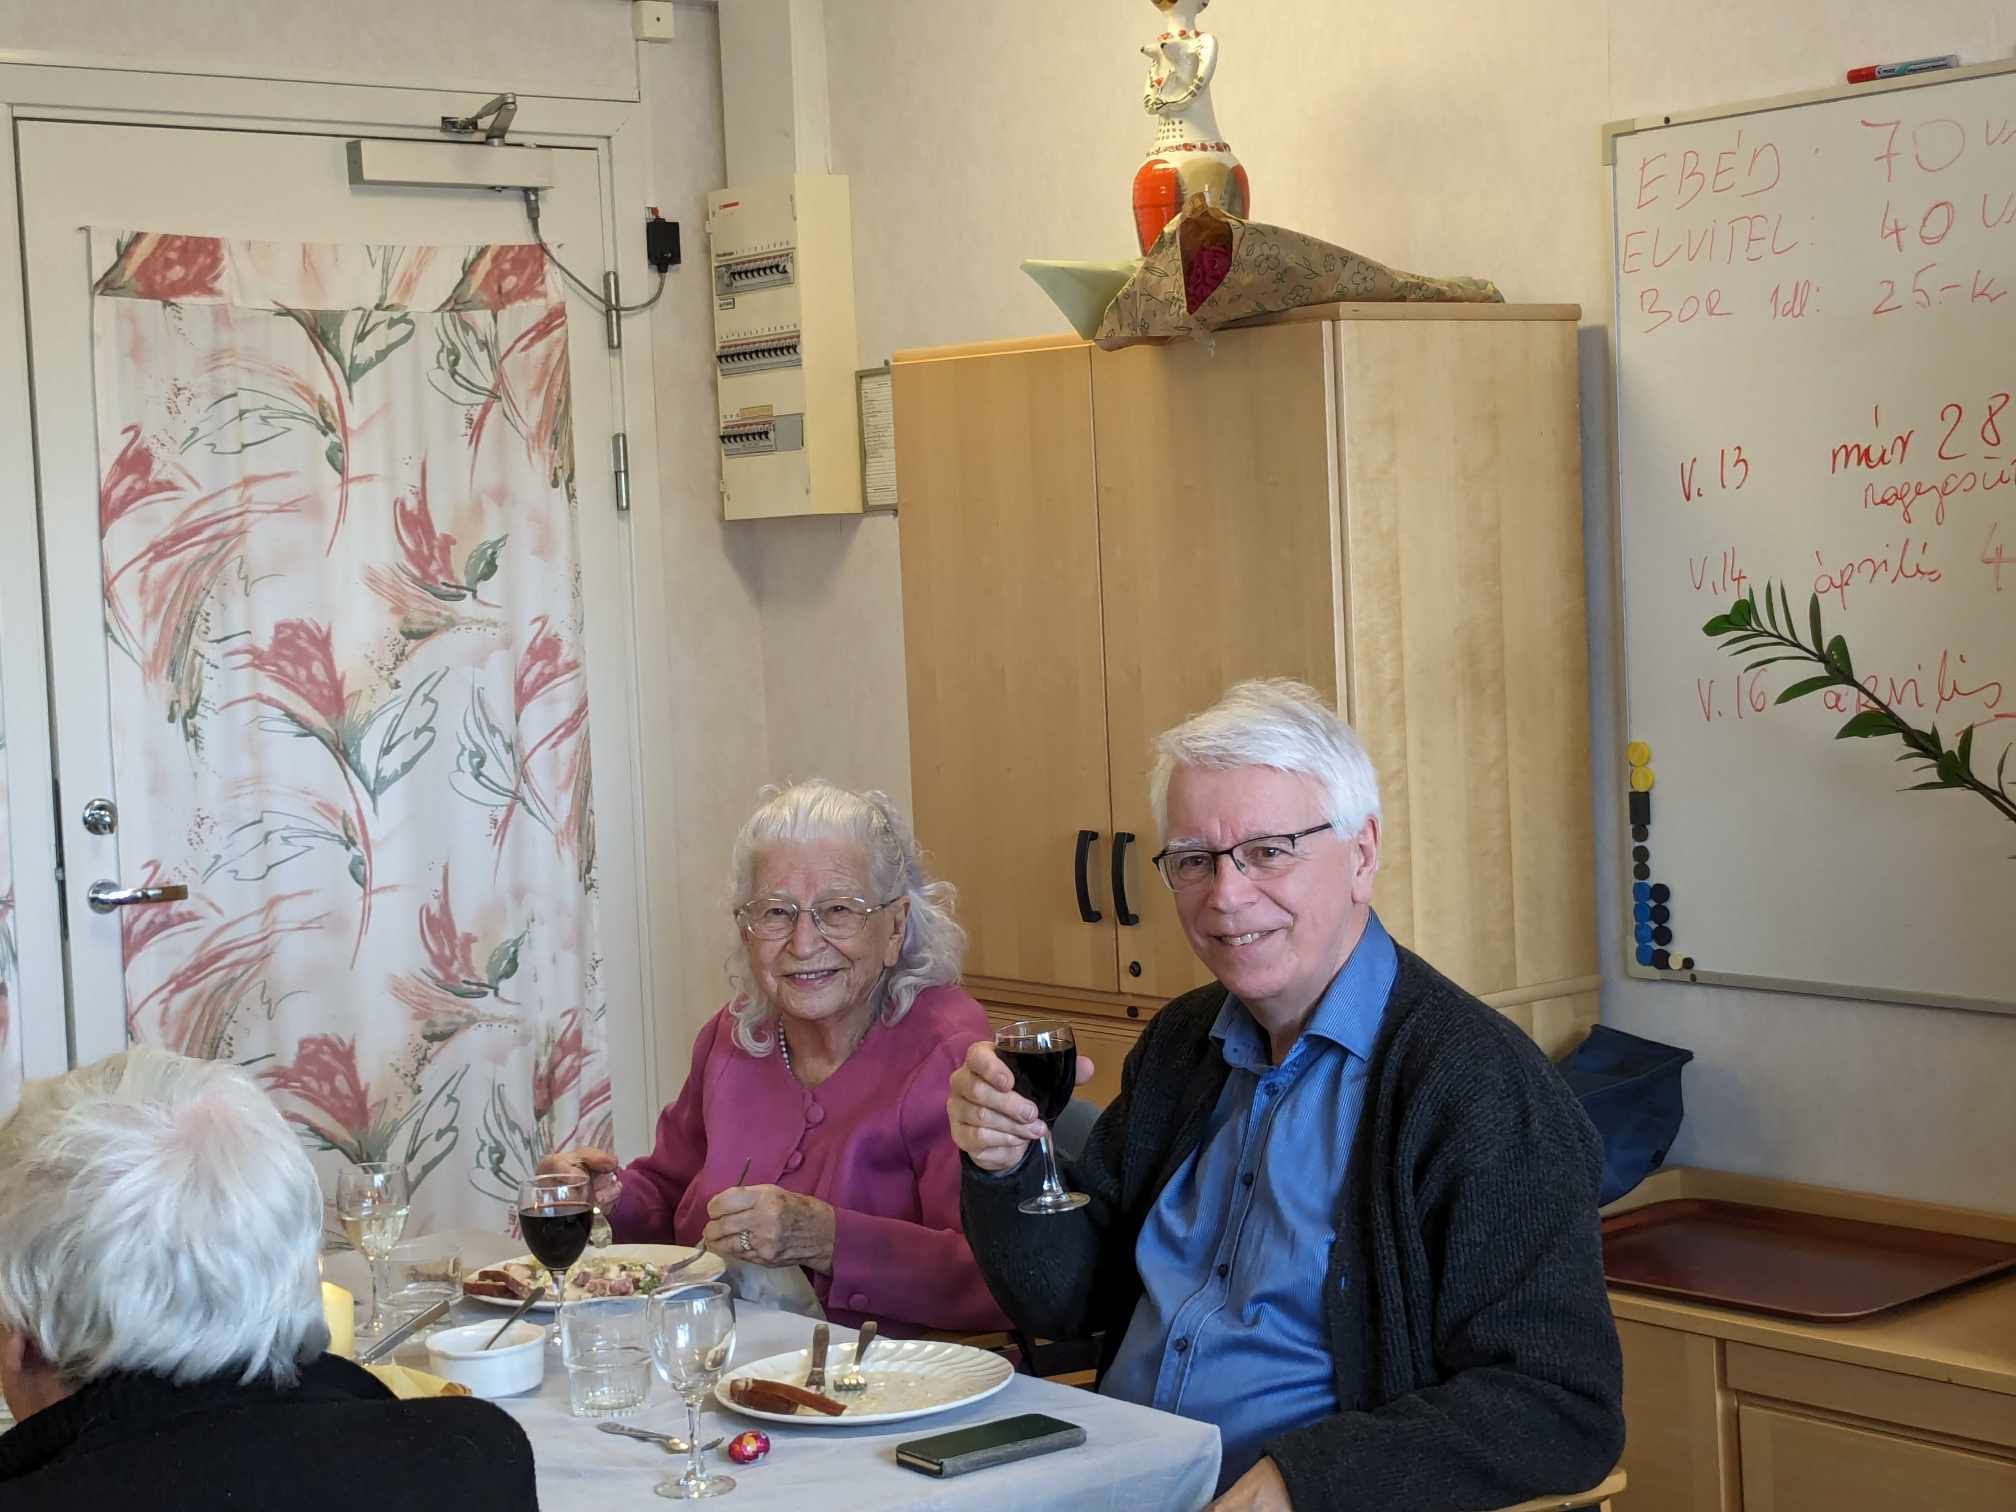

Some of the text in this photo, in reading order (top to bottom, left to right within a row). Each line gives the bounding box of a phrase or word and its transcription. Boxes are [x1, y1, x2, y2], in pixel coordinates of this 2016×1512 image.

[1860, 118, 1966, 183] 70
[1880, 199, 1955, 253] 40
[1640, 287, 1734, 334] BOR
[1937, 393, 2011, 461] 28
